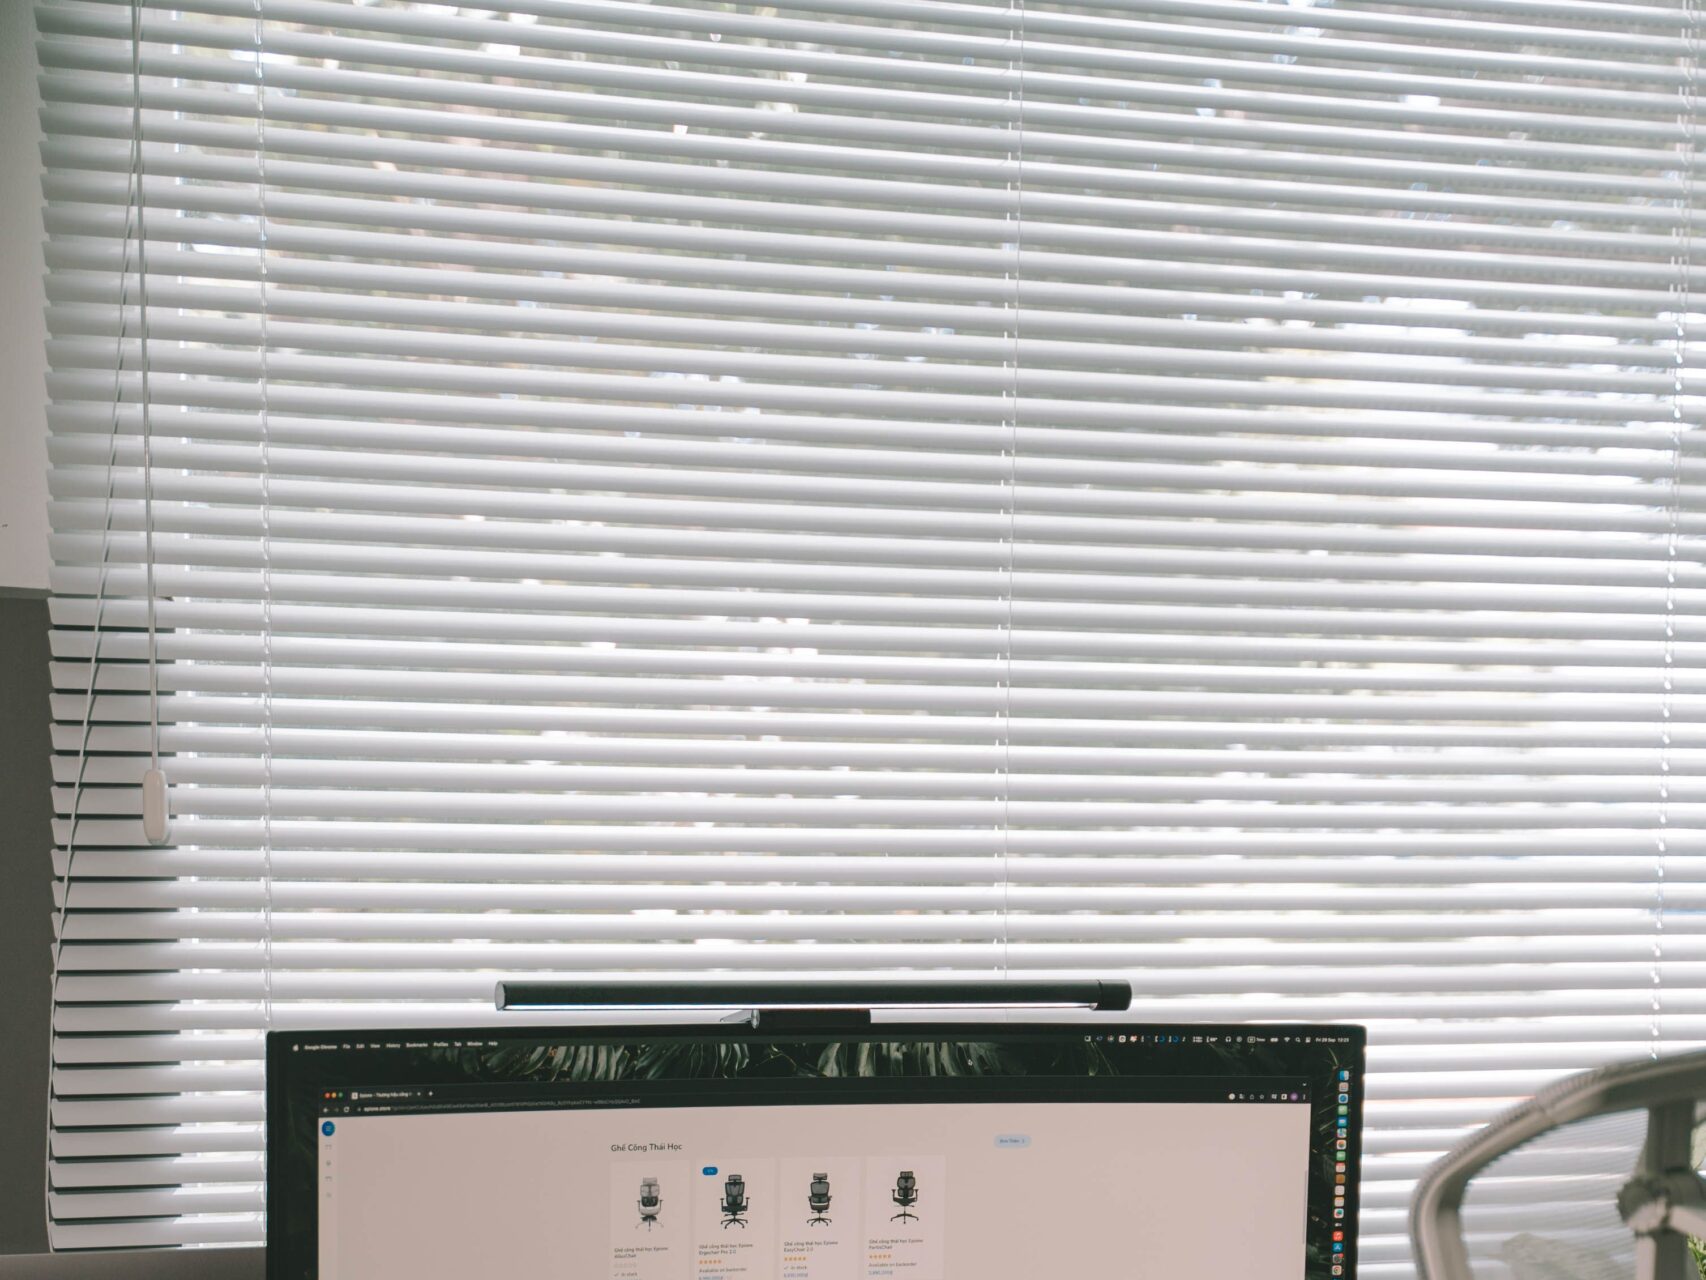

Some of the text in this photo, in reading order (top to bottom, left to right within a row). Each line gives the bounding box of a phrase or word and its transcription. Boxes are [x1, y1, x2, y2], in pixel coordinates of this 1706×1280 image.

[628, 1143, 647, 1152] Công
[649, 1143, 665, 1152] Thái
[667, 1143, 682, 1152] Học
